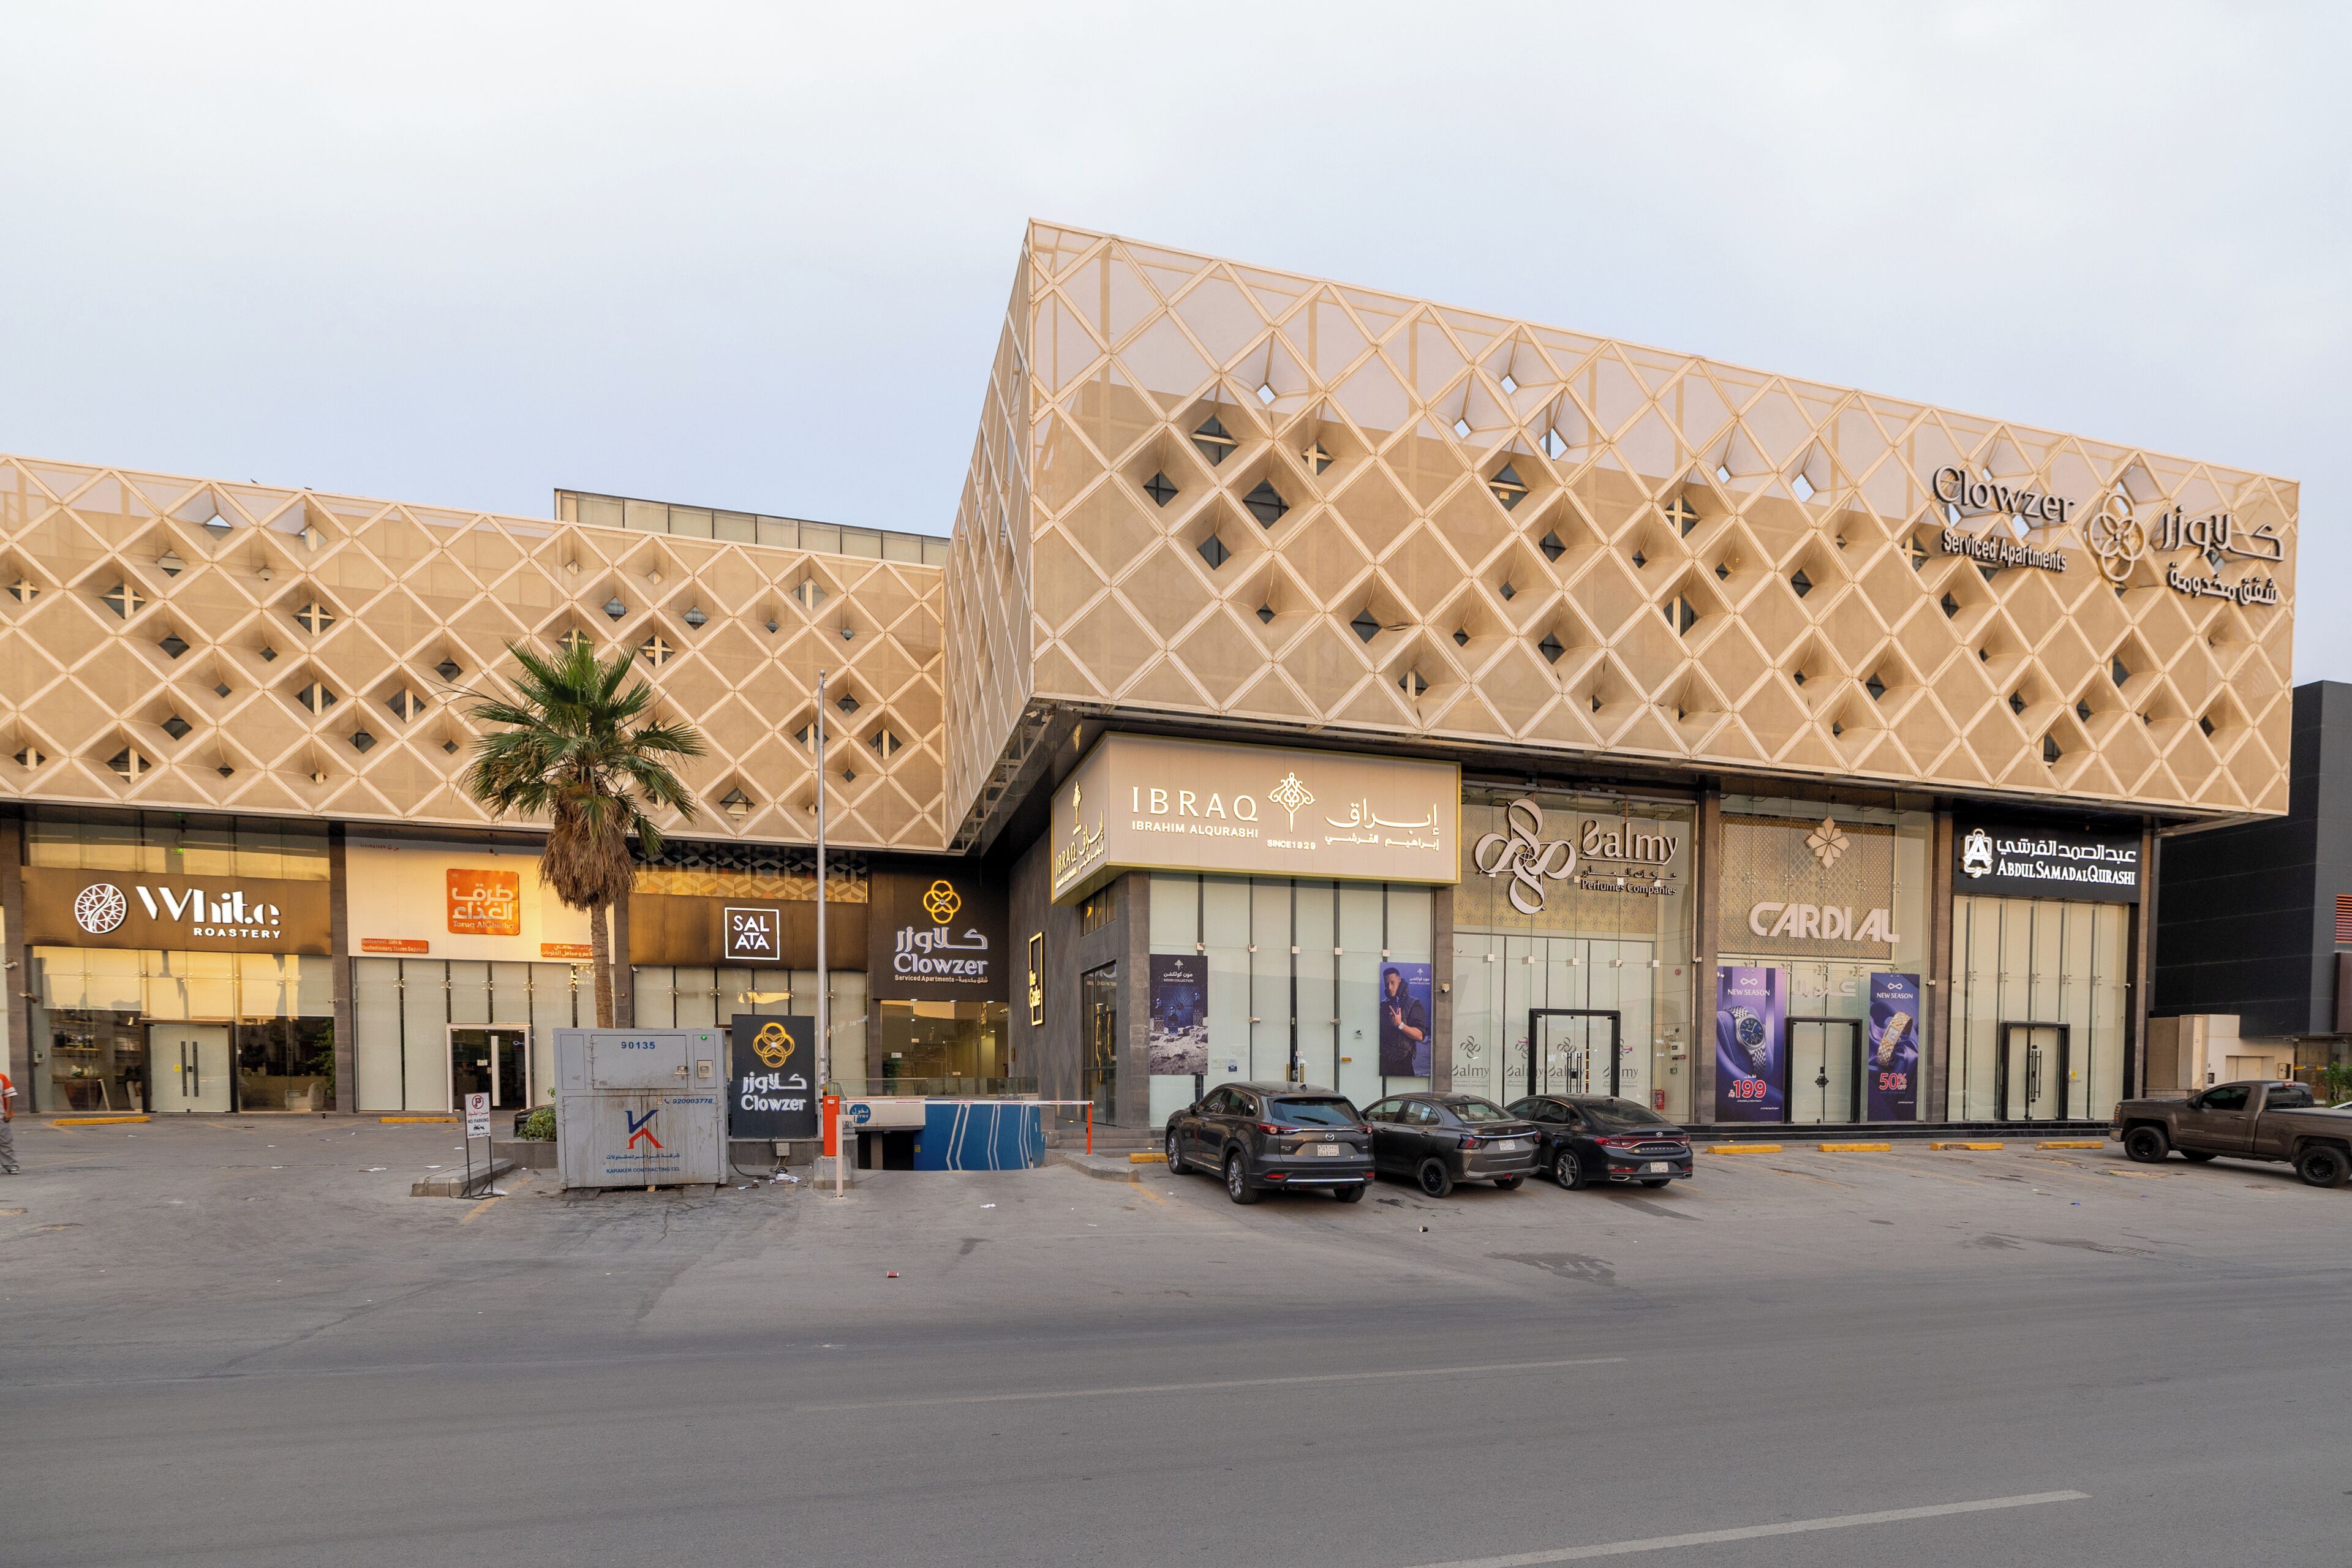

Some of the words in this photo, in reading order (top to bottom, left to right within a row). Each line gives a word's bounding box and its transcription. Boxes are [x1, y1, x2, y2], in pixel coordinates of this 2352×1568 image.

[1933, 464, 2076, 522] Clowzer
[2162, 504, 2285, 561] كلاوزر
[1942, 528, 1997, 559] Serviced
[1999, 538, 2067, 572] Apartments
[2166, 562, 2236, 601] مخدومة
[2237, 577, 2279, 606] شقق
[1132, 786, 1258, 822] IBRAQ
[1325, 797, 1439, 836] إبراق
[1132, 821, 1185, 834] IBRAHIM
[1189, 825, 1258, 839] ALQURASHI
[1582, 819, 1679, 865] Balmy
[1997, 839, 2057, 858] القرشي
[1056, 842, 1077, 876] IBRAQ
[1996, 858, 2035, 878] ABDUL
[2036, 861, 2077, 880] SAMAD
[2087, 865, 2136, 885] QURASHI
[452, 883, 514, 906] طرق
[1581, 880, 1625, 892] Perfumes
[1627, 883, 1677, 897] Companies
[135, 886, 280, 925] White
[452, 901, 514, 920] الغذاء
[193, 927, 281, 939] ROASTERY
[453, 921, 475, 929] Toruq
[733, 915, 770, 932] SAL
[1749, 902, 1900, 943] CARDIAL
[734, 932, 770, 949] ATA
[895, 926, 988, 954] كلاوزر
[894, 953, 989, 975] Clowzer
[741, 1071, 807, 1094] كلاوزر
[1506, 1064, 1544, 1078] Baly
[1602, 1065, 1638, 1079] Bmy
[1733, 1079, 1766, 1098] 199
[741, 1095, 807, 1111] Clowzer
